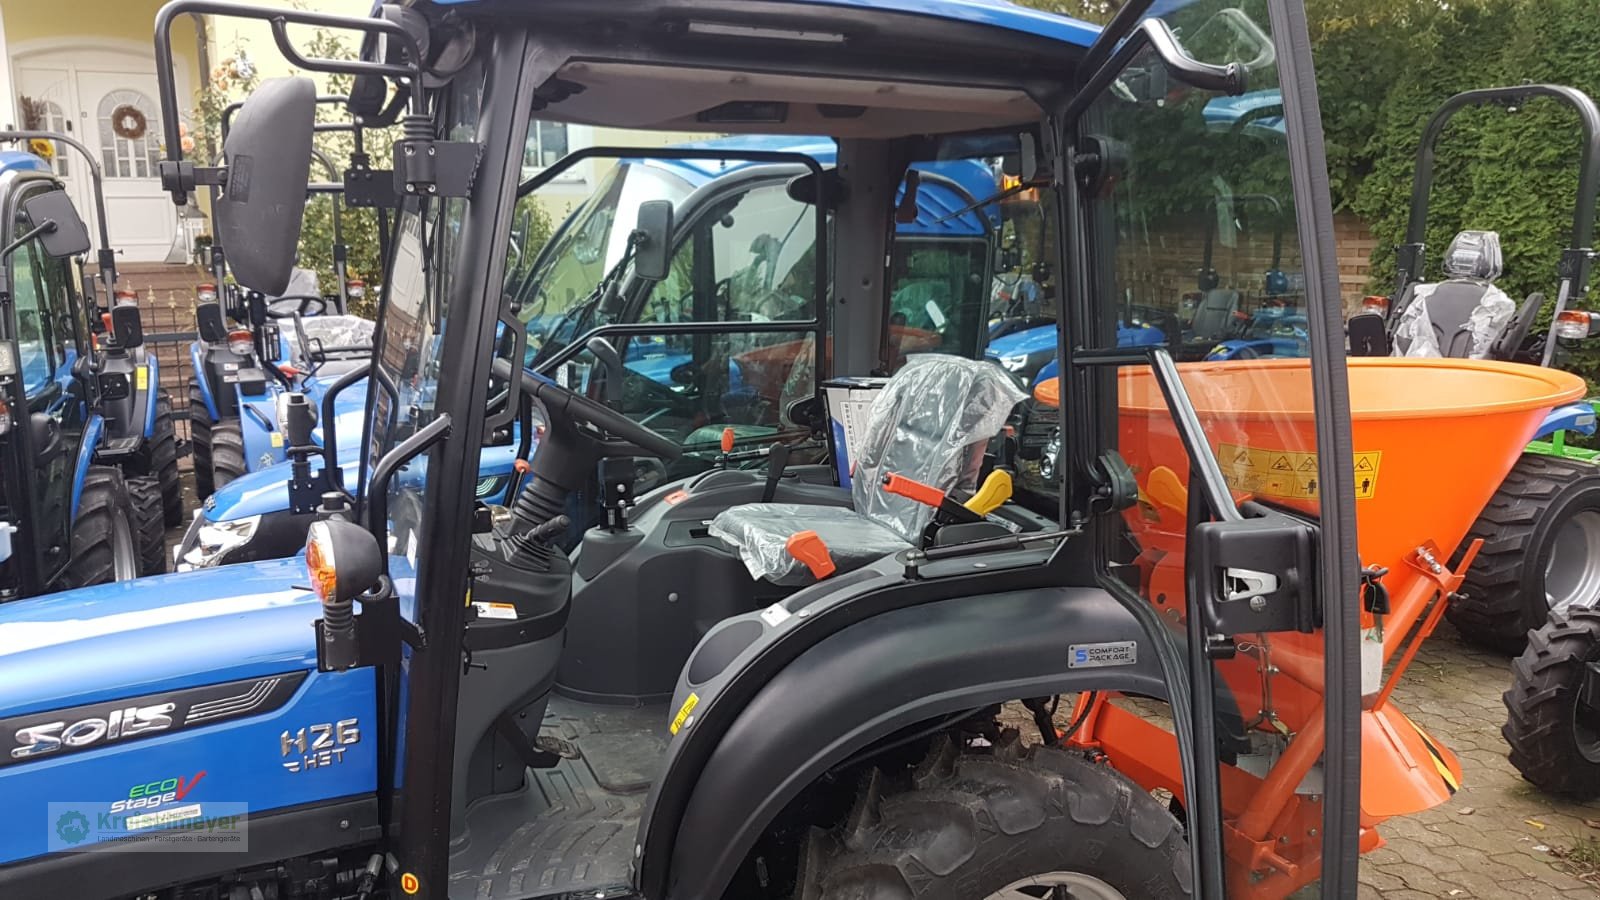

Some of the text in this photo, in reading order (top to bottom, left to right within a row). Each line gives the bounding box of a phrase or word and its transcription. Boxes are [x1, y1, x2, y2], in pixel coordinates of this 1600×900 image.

[1089, 653, 1129, 661] PACKAGE
[303, 747, 347, 770] HST
[404, 875, 417, 891] D
